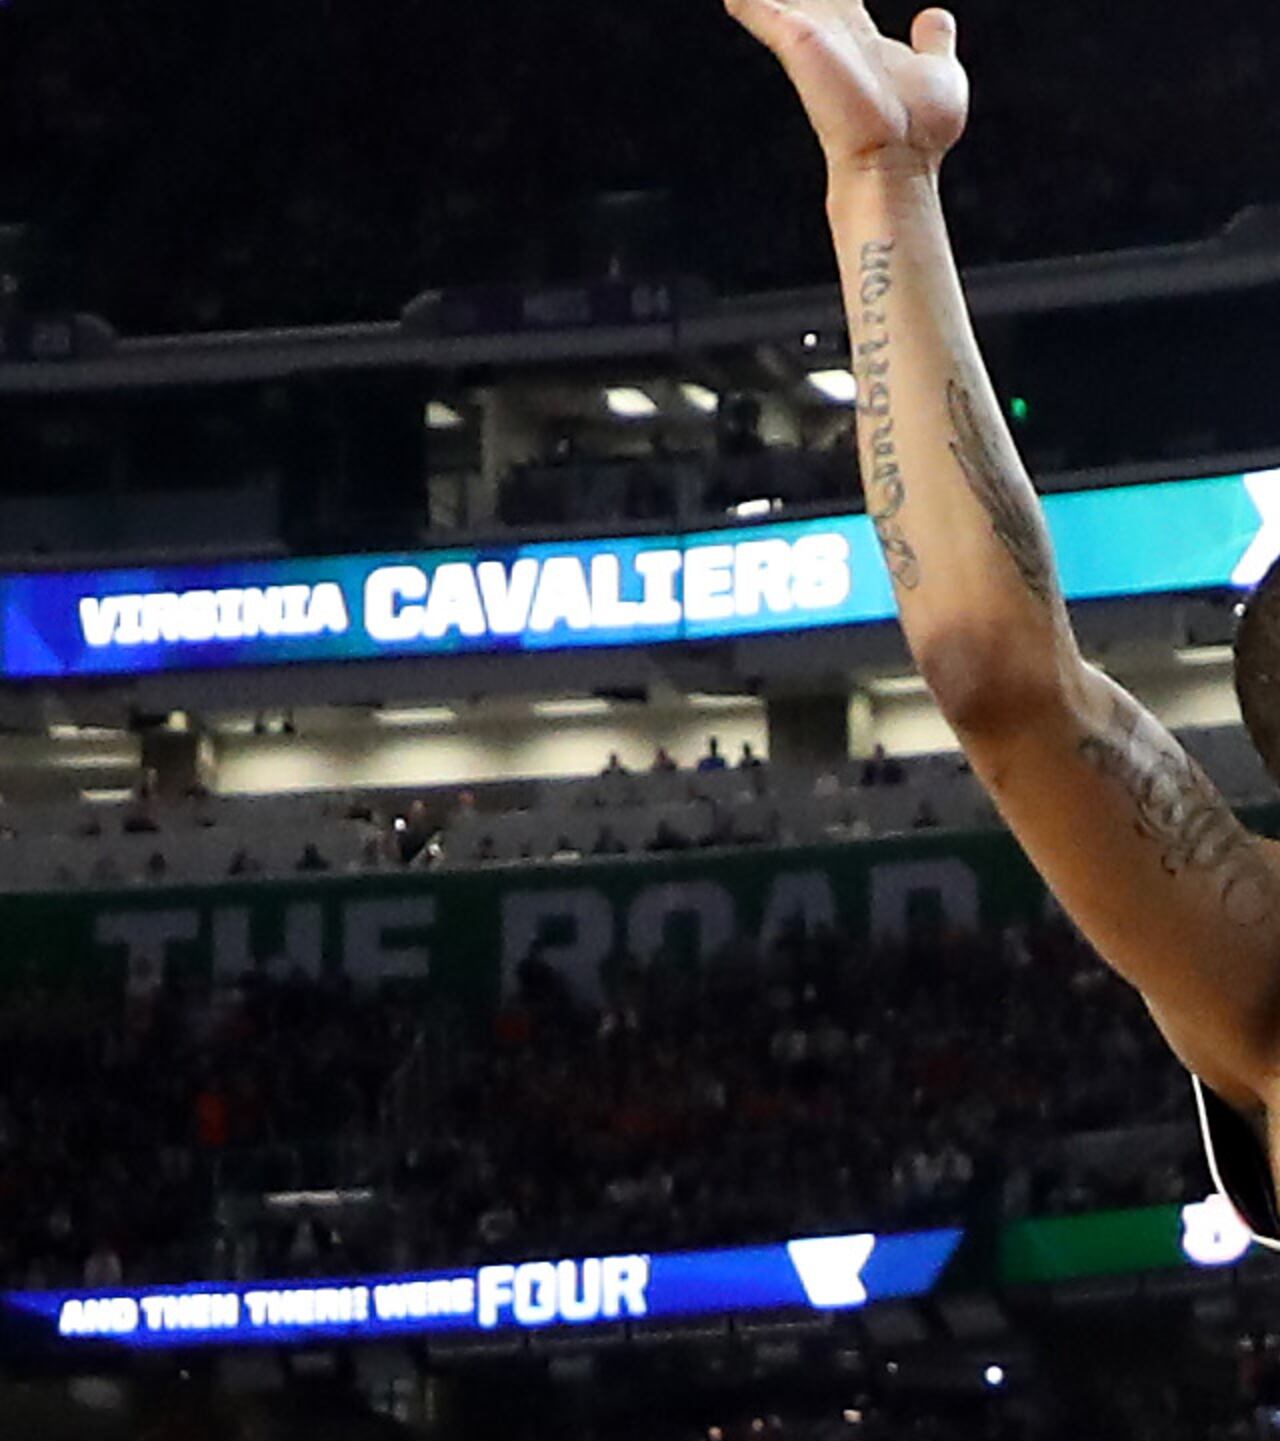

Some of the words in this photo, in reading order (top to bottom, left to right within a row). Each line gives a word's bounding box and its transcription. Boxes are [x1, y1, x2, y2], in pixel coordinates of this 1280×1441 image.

[79, 582, 349, 647] VIRGINIA
[363, 532, 851, 643] CAVALIERS
[93, 892, 438, 990] THE
[478, 1253, 651, 1328] FOUR
